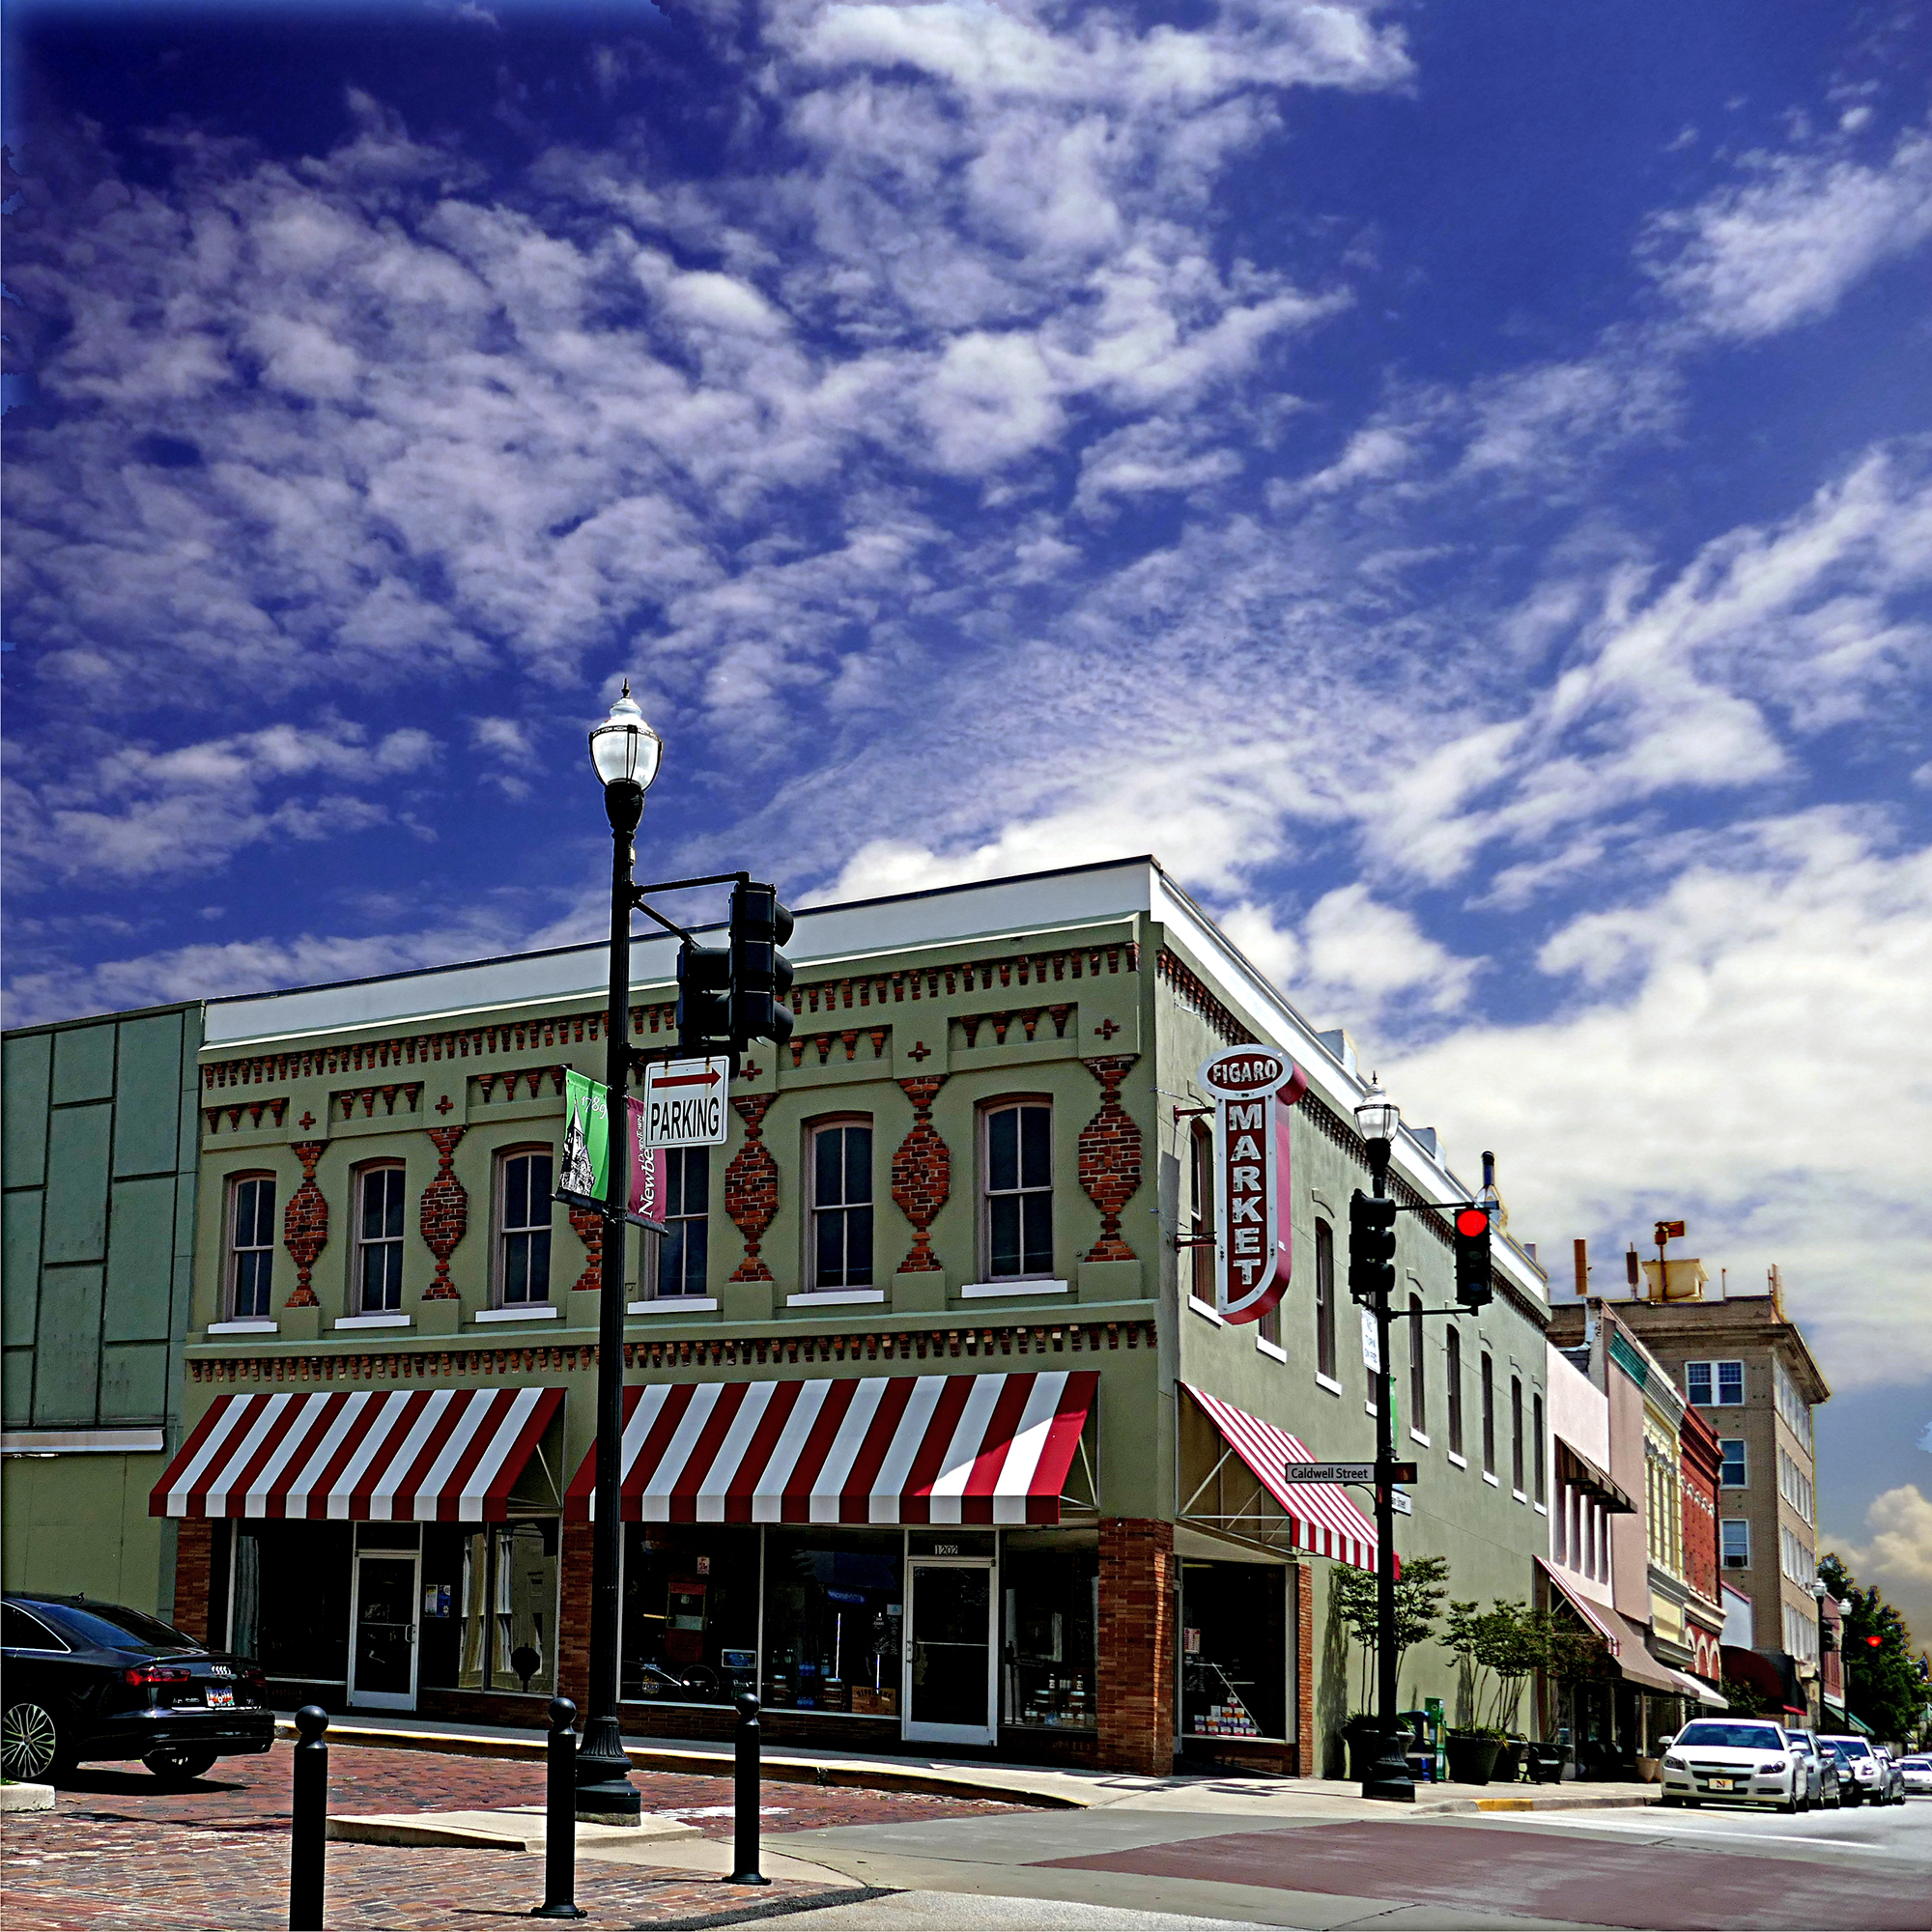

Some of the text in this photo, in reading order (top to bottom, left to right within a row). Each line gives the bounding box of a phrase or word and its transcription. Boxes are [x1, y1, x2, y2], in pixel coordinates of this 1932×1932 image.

[1212, 1060, 1277, 1084] FIGARO
[581, 1095, 608, 1120] 1789
[650, 1096, 719, 1141] PARKING
[638, 1148, 655, 1218] Newbe
[1229, 1103, 1264, 1285] MARKET
[1291, 1467, 1368, 1479] Caldwell Street
[935, 1545, 957, 1555] 1202
